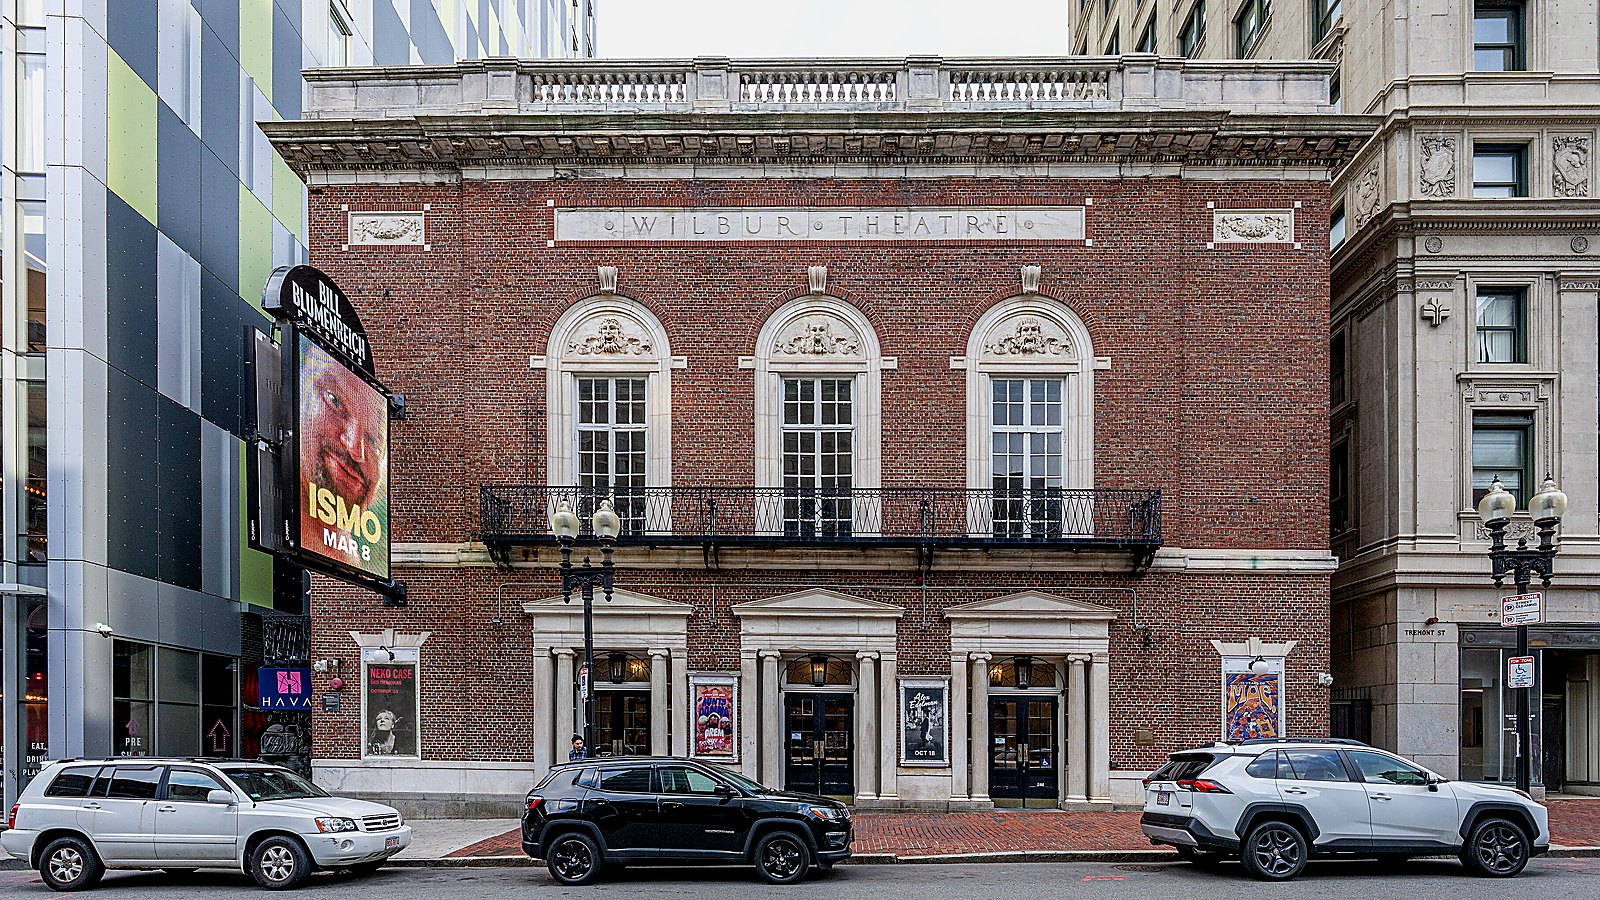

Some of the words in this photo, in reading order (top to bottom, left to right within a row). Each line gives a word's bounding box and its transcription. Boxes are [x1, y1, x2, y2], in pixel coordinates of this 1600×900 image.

[631, 216, 799, 235] WILBUR
[839, 215, 1008, 235] THEATRE
[318, 280, 342, 318] BILL
[292, 280, 366, 361] BLUMENREICH
[297, 310, 363, 366] PRESENTS
[308, 482, 381, 544] ISMO
[323, 528, 359, 557] MAR
[361, 544, 371, 562] 8
[370, 668, 391, 679] NEKO
[393, 668, 412, 679] CASE
[913, 692, 931, 701] Alex
[125, 737, 141, 746] PRE
